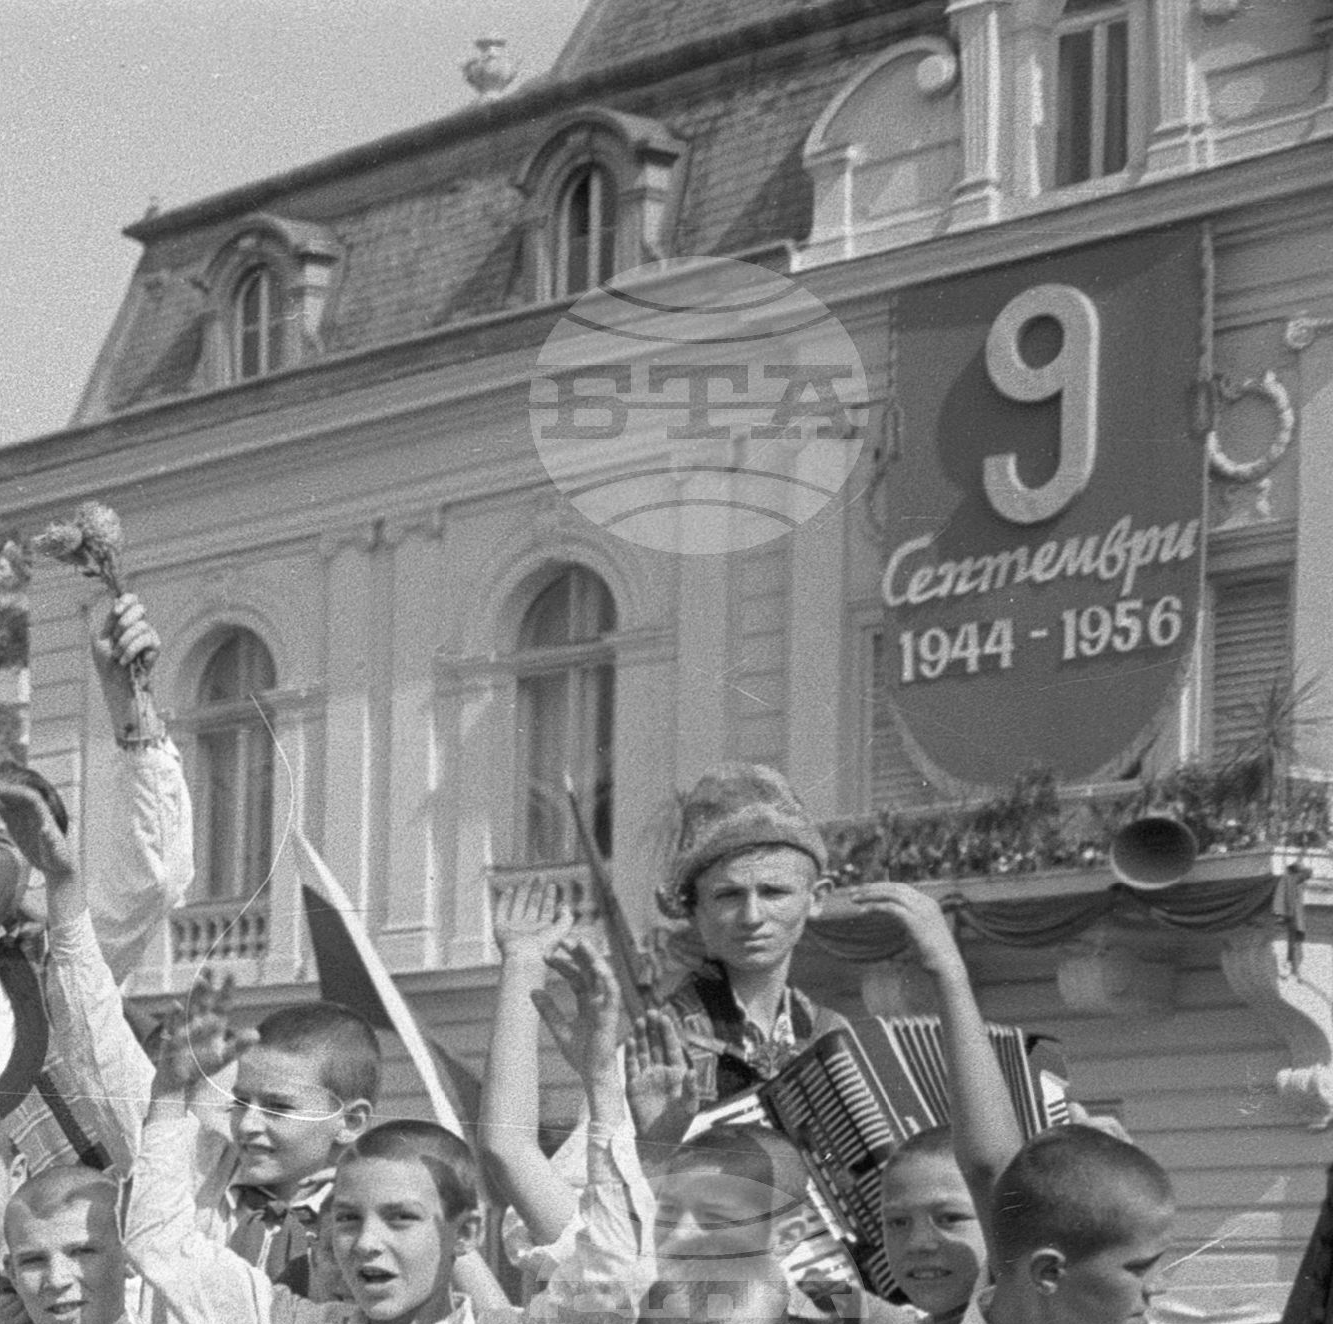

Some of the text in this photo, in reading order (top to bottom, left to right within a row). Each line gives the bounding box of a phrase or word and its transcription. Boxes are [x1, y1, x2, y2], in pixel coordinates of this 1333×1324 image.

[984, 283, 1100, 524] 9
[882, 514, 1201, 607] Септември
[899, 617, 1015, 683] 1944
[1061, 595, 1183, 661] 1956
